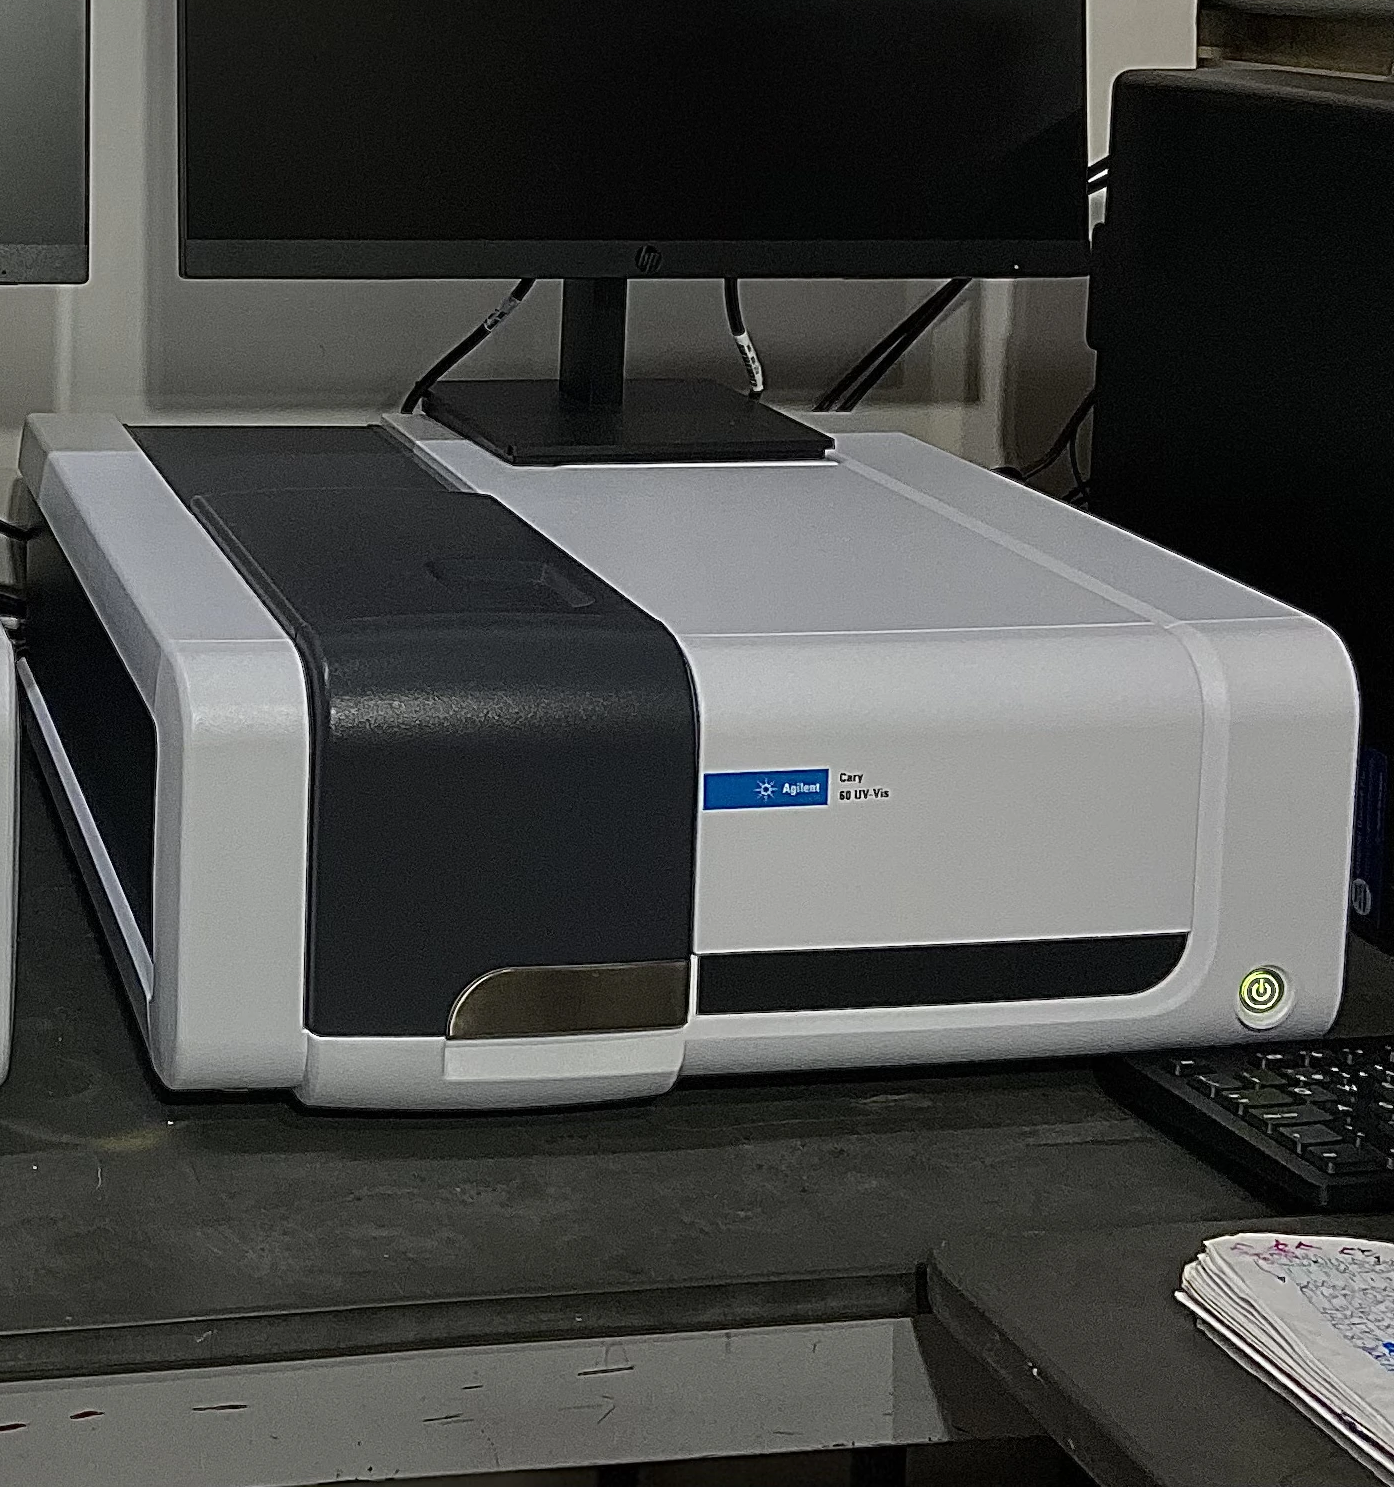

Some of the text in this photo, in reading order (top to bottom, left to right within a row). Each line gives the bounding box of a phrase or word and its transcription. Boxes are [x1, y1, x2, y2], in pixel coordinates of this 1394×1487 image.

[839, 773, 864, 783] Cary
[782, 783, 820, 796] Agilent
[839, 788, 890, 800] 60 UV-Vis
